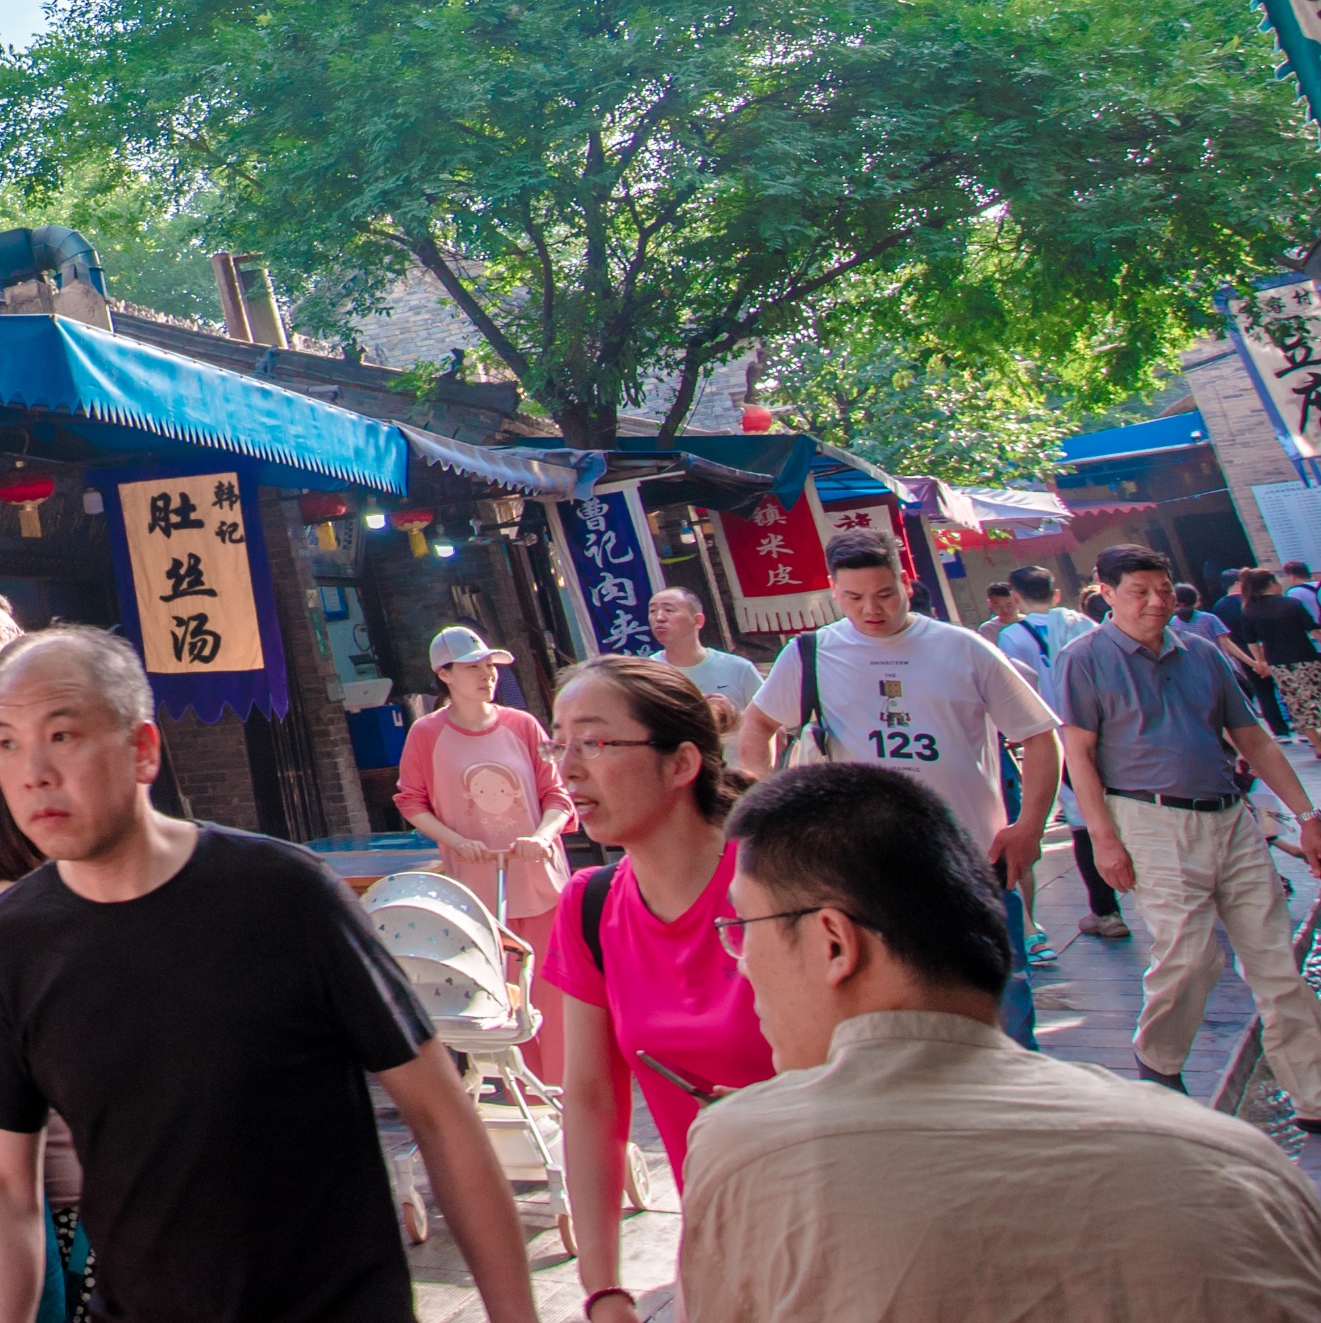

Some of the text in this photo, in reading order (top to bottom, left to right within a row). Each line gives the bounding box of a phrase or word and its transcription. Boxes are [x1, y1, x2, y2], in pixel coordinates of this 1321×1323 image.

[212, 481, 245, 544] 韩记
[149, 492, 221, 665] 肚丝汤
[868, 730, 939, 762] 123
